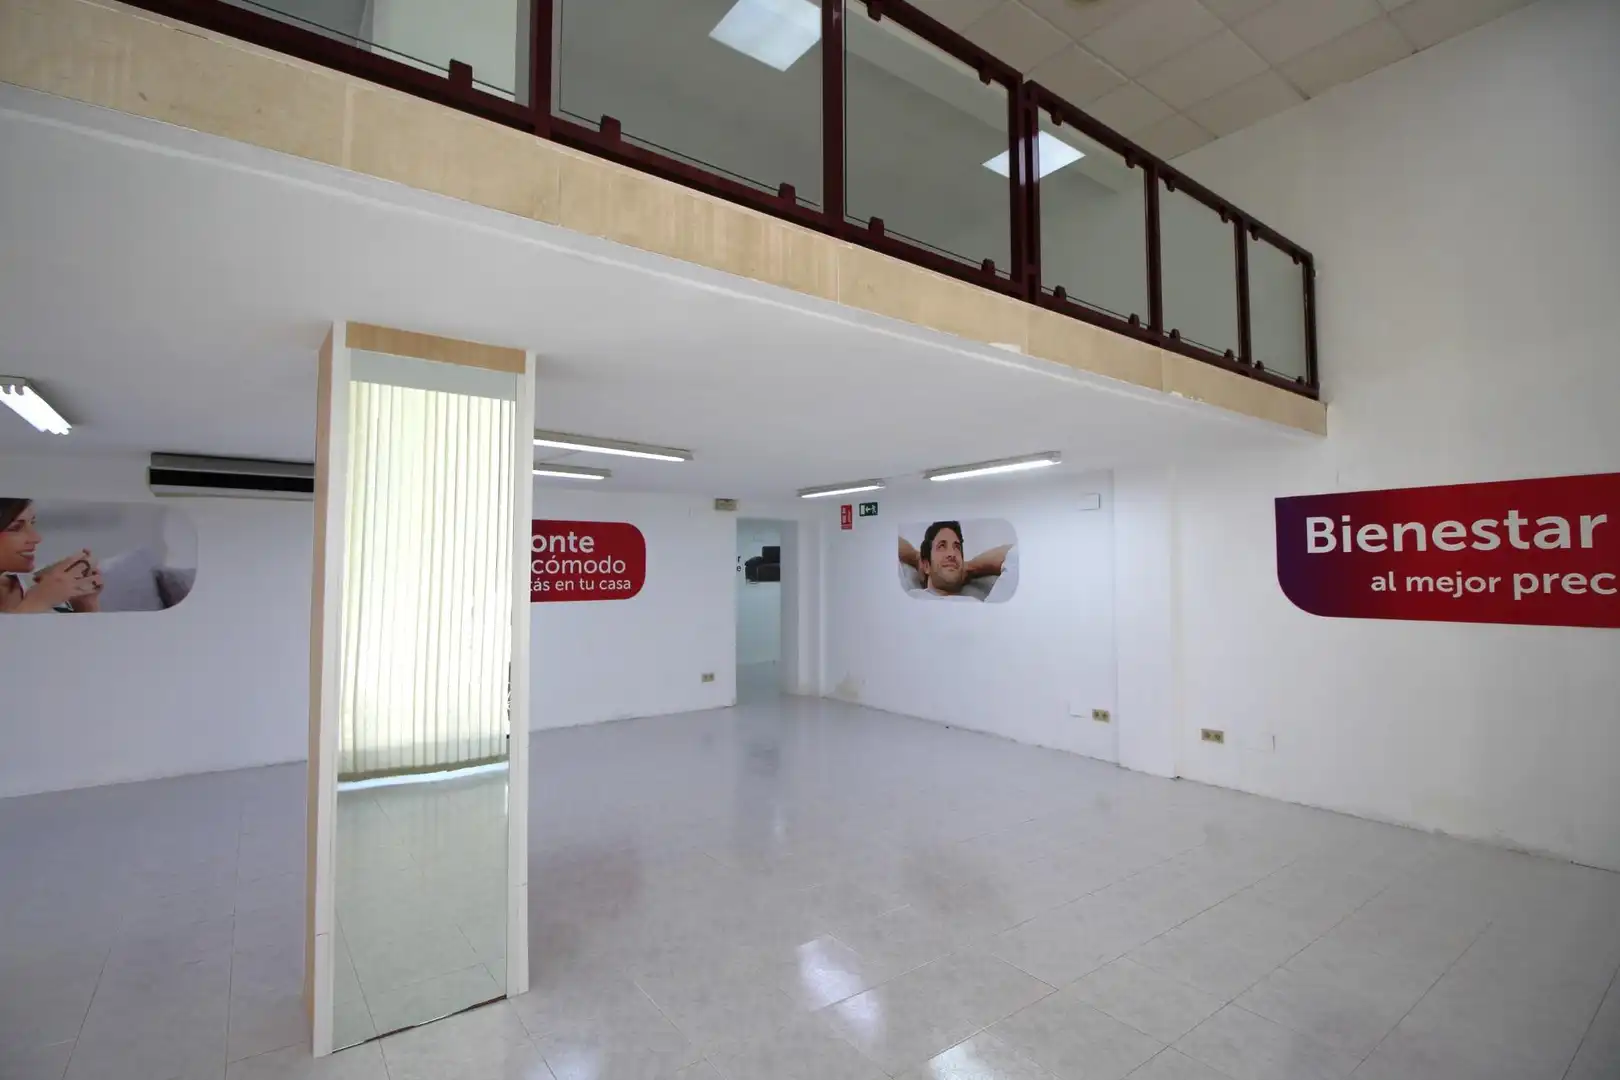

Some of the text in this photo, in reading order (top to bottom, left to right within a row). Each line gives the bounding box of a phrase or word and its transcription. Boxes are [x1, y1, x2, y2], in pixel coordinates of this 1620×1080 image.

[1306, 509, 1608, 554] Bienestar
[531, 555, 626, 574] cómodo
[555, 580, 574, 591] en
[579, 577, 595, 590] tu
[599, 579, 631, 590] casa
[1370, 571, 1397, 592] al
[1405, 571, 1502, 598] mejor
